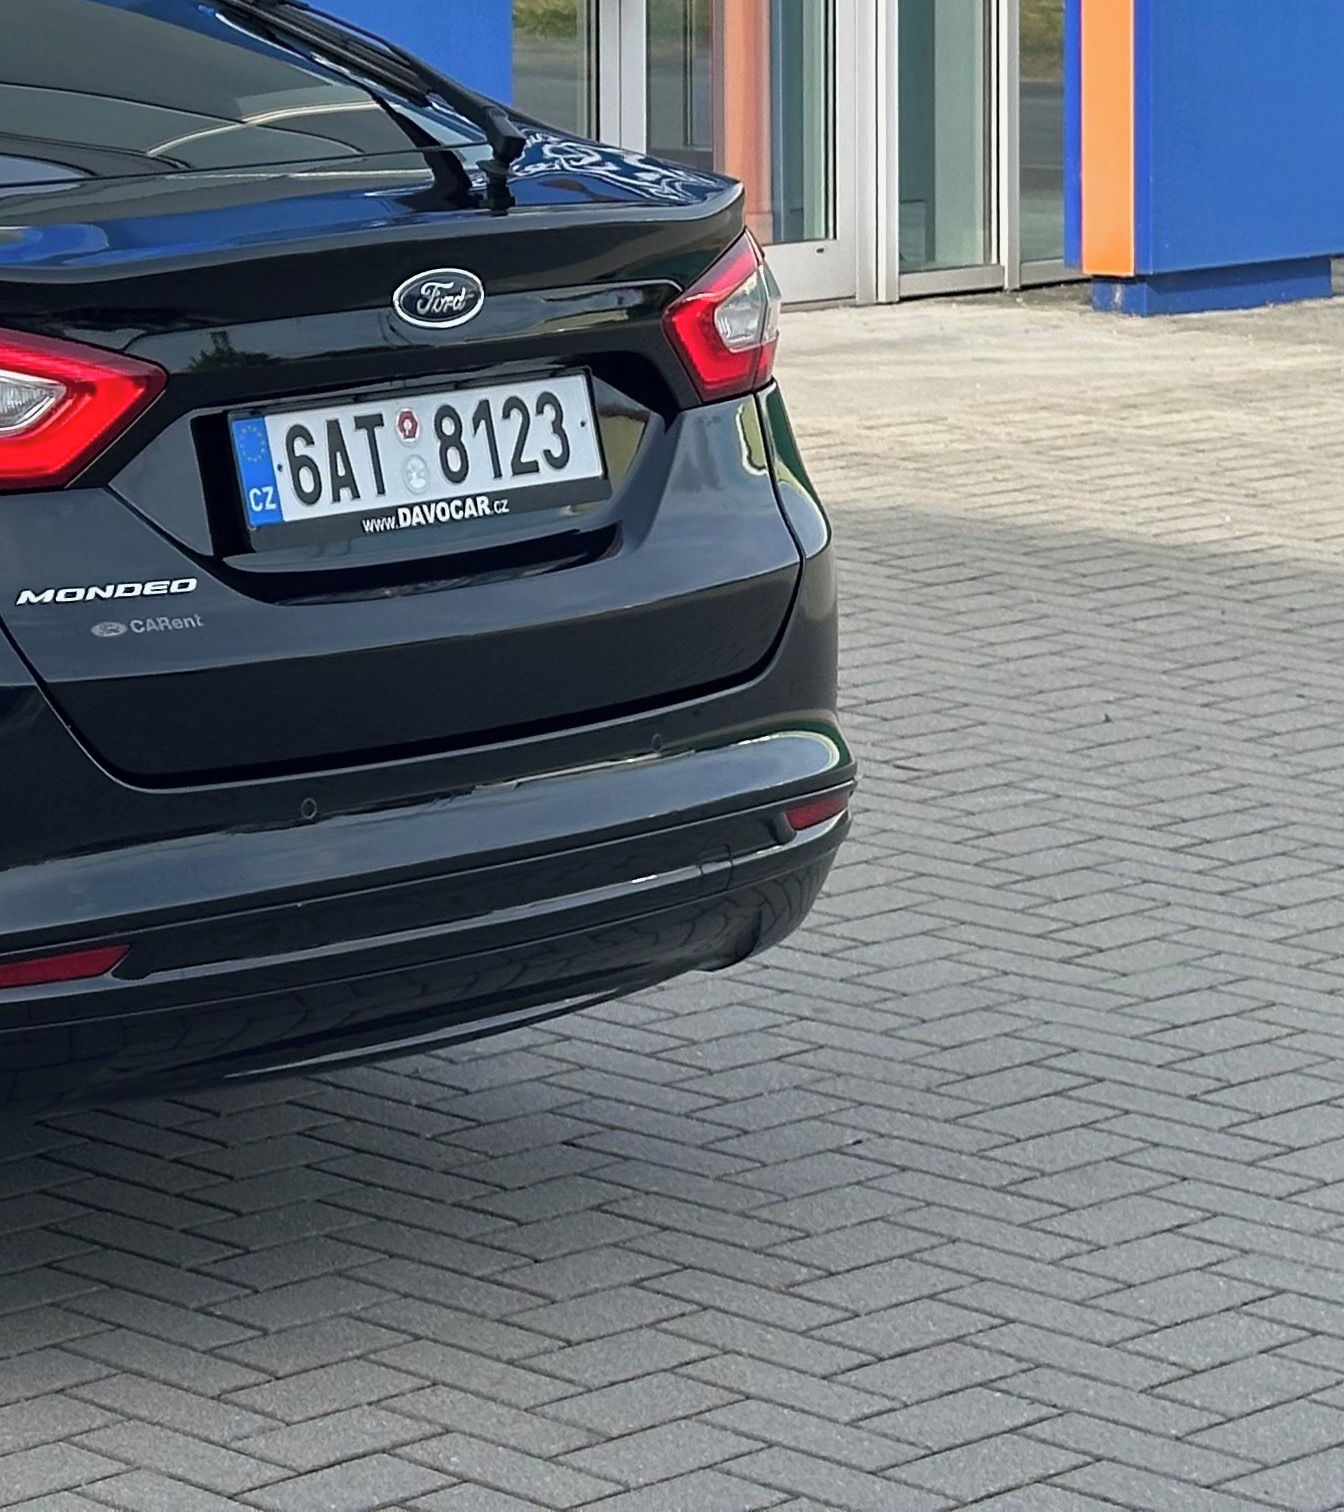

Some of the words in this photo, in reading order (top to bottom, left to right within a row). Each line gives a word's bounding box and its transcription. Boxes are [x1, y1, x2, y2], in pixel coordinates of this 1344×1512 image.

[416, 281, 467, 315] Ford
[285, 413, 386, 506] 6AT
[433, 391, 571, 485] 8123
[248, 486, 277, 513] CZ
[15, 577, 198, 606] MONDEO
[129, 614, 205, 634] CARent
